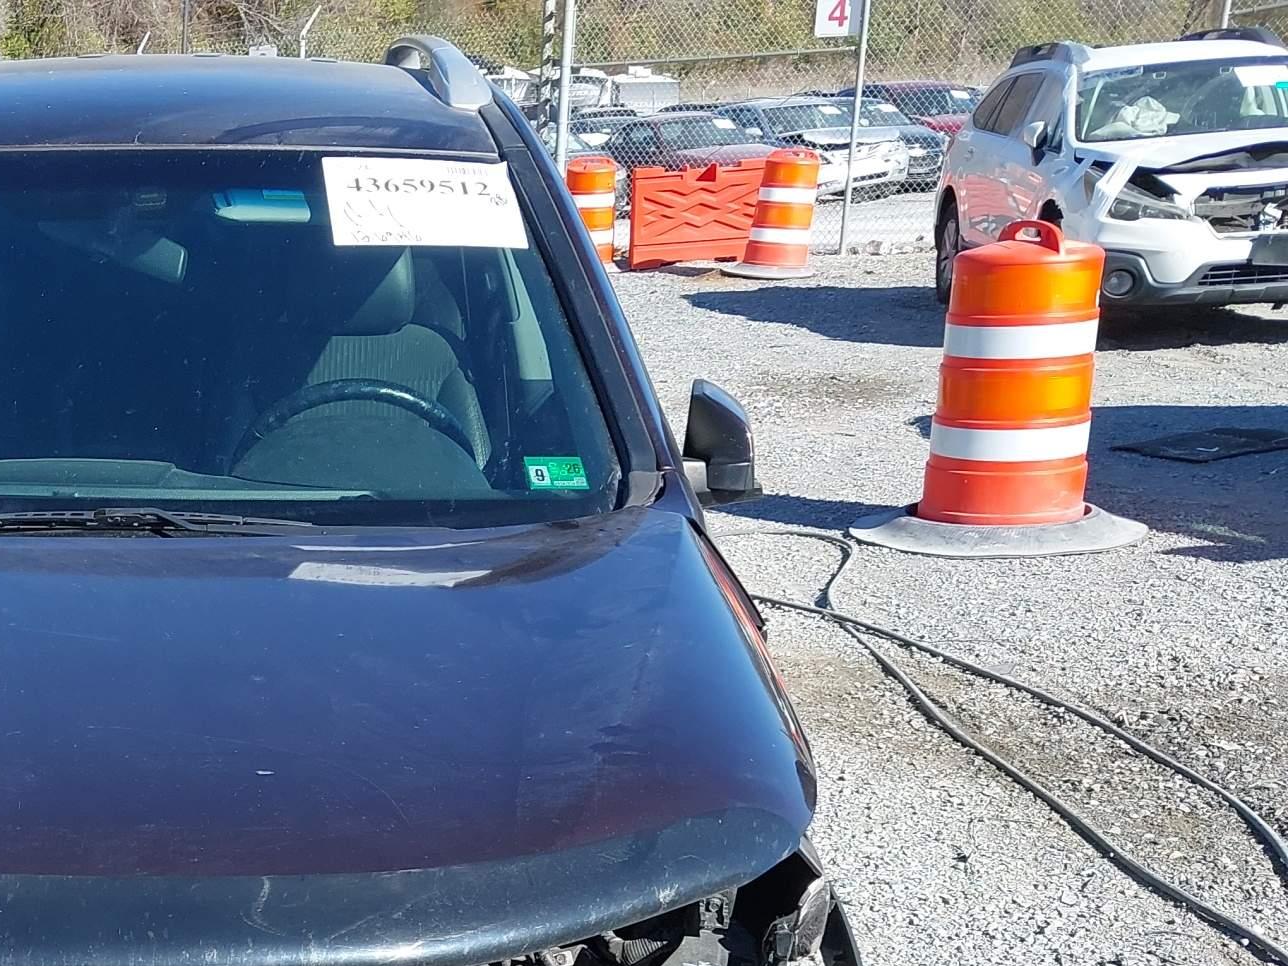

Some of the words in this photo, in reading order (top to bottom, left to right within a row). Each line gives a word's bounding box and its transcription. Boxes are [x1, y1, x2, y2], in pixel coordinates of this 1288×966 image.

[828, 0, 849, 27] 4
[346, 176, 491, 197] 43659512
[534, 468, 546, 482] 9
